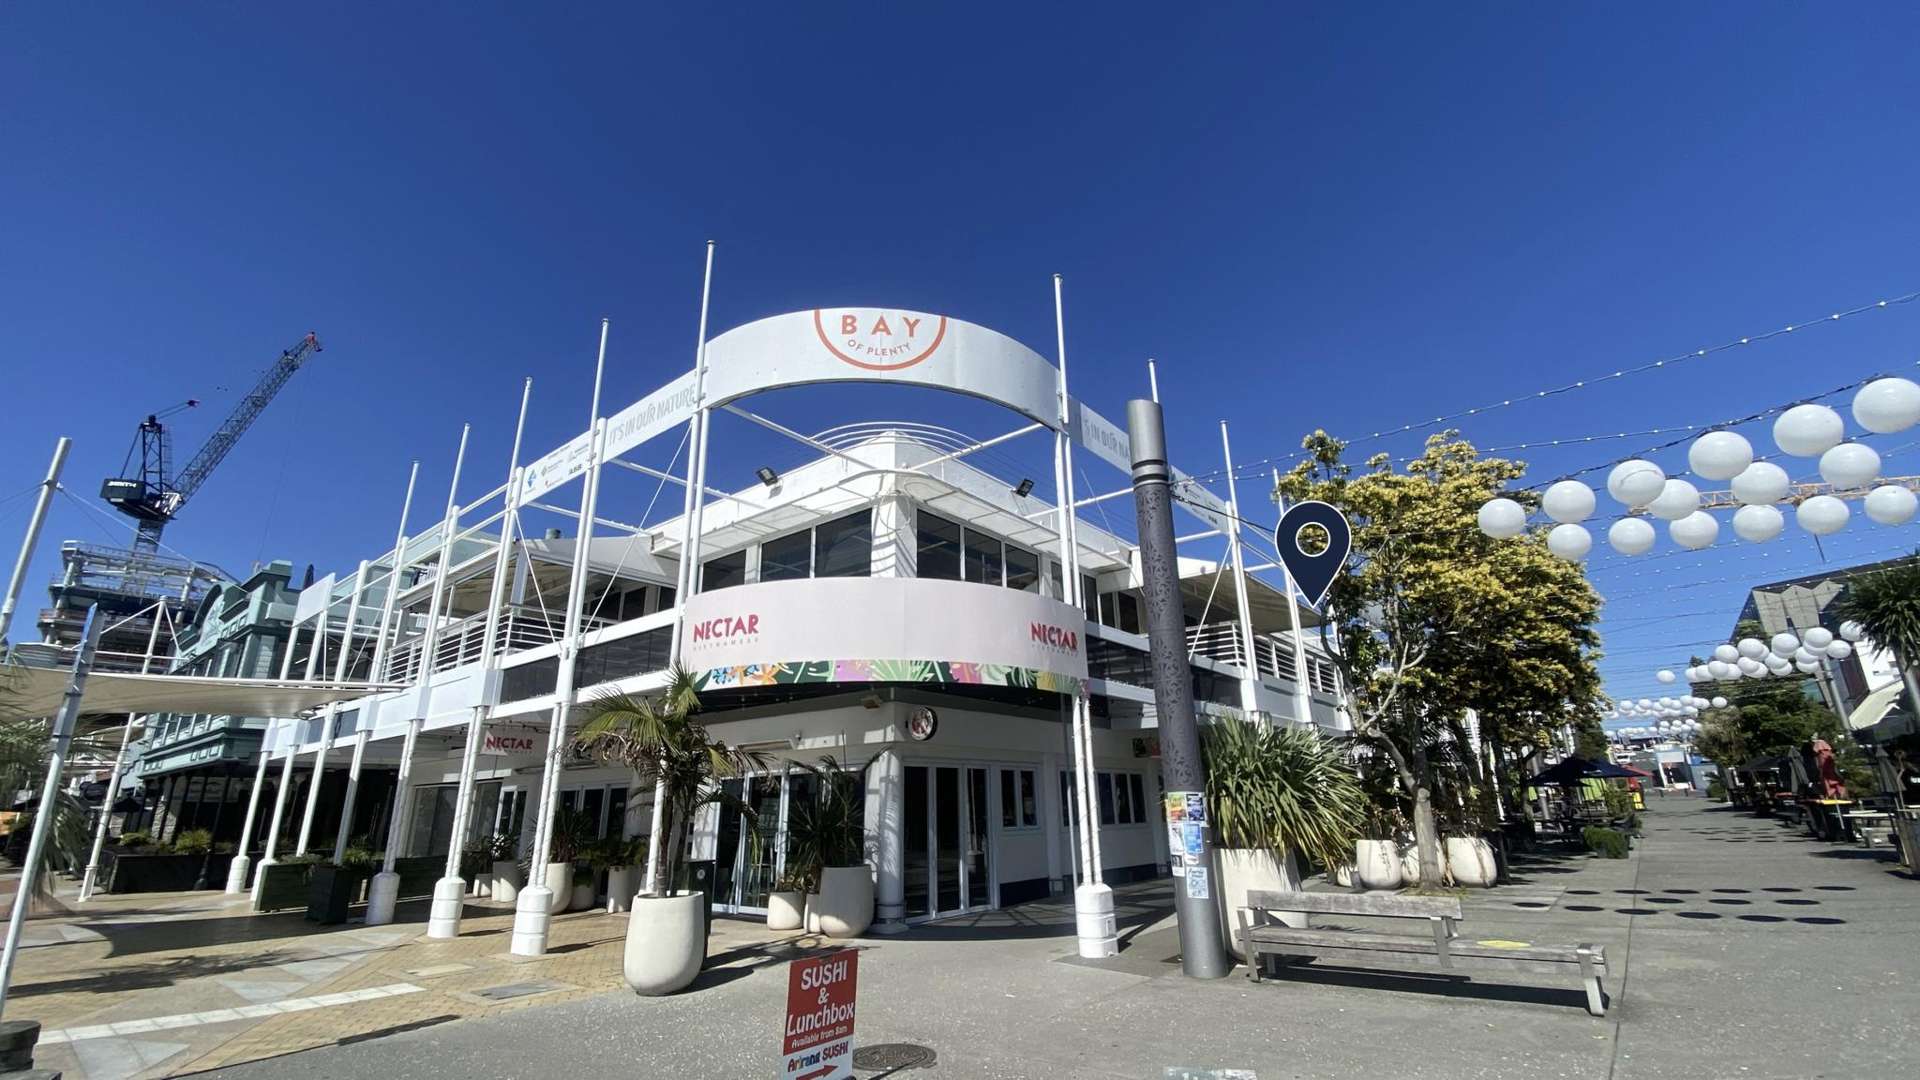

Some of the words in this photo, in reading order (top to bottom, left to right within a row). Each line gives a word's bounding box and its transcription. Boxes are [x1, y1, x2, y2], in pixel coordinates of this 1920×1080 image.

[841, 315, 921, 338] BAY
[847, 339, 863, 352] OF
[866, 342, 911, 357] PLENTY
[625, 417, 635, 438] IN
[636, 403, 656, 431] OUR
[657, 384, 698, 420] NATURE
[693, 614, 759, 643] NECTAR
[1031, 622, 1078, 650] NECTAR
[486, 736, 533, 750] NECTAR
[800, 960, 848, 991] SUSHI
[818, 987, 830, 1005] &
[786, 1002, 856, 1037] Lunchbox
[822, 1041, 849, 1061] SUSHI
